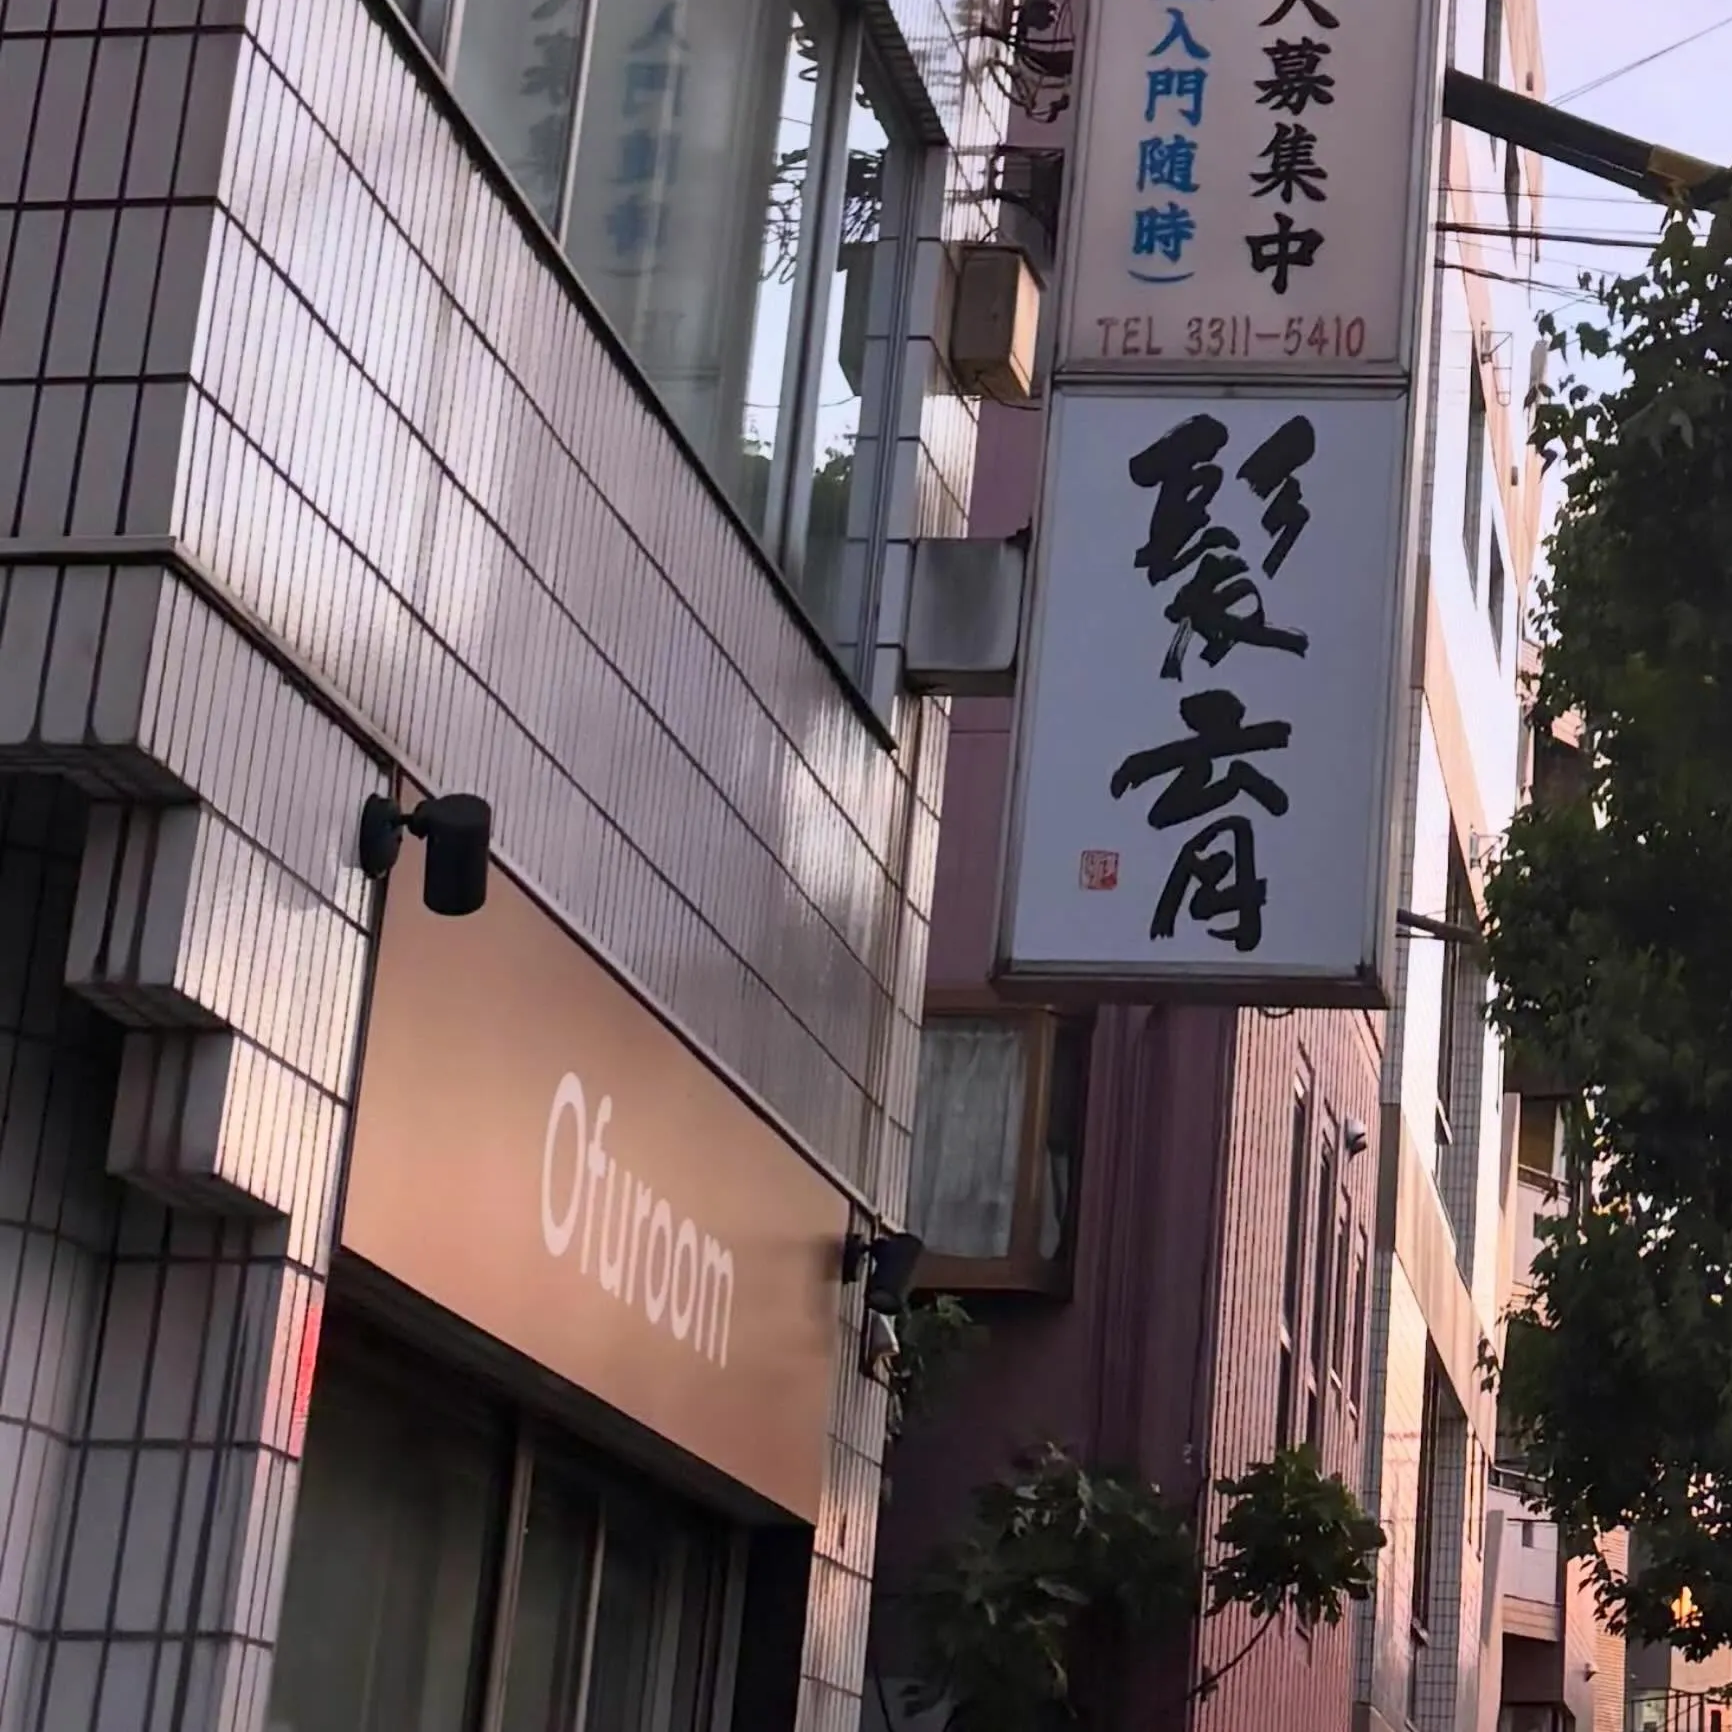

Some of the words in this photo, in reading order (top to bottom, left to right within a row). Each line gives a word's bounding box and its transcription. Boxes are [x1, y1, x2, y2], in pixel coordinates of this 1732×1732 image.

[1096, 317, 1163, 357] TEL
[1186, 317, 1366, 358] 3311-5410
[540, 1071, 735, 1368] Ofuroom
